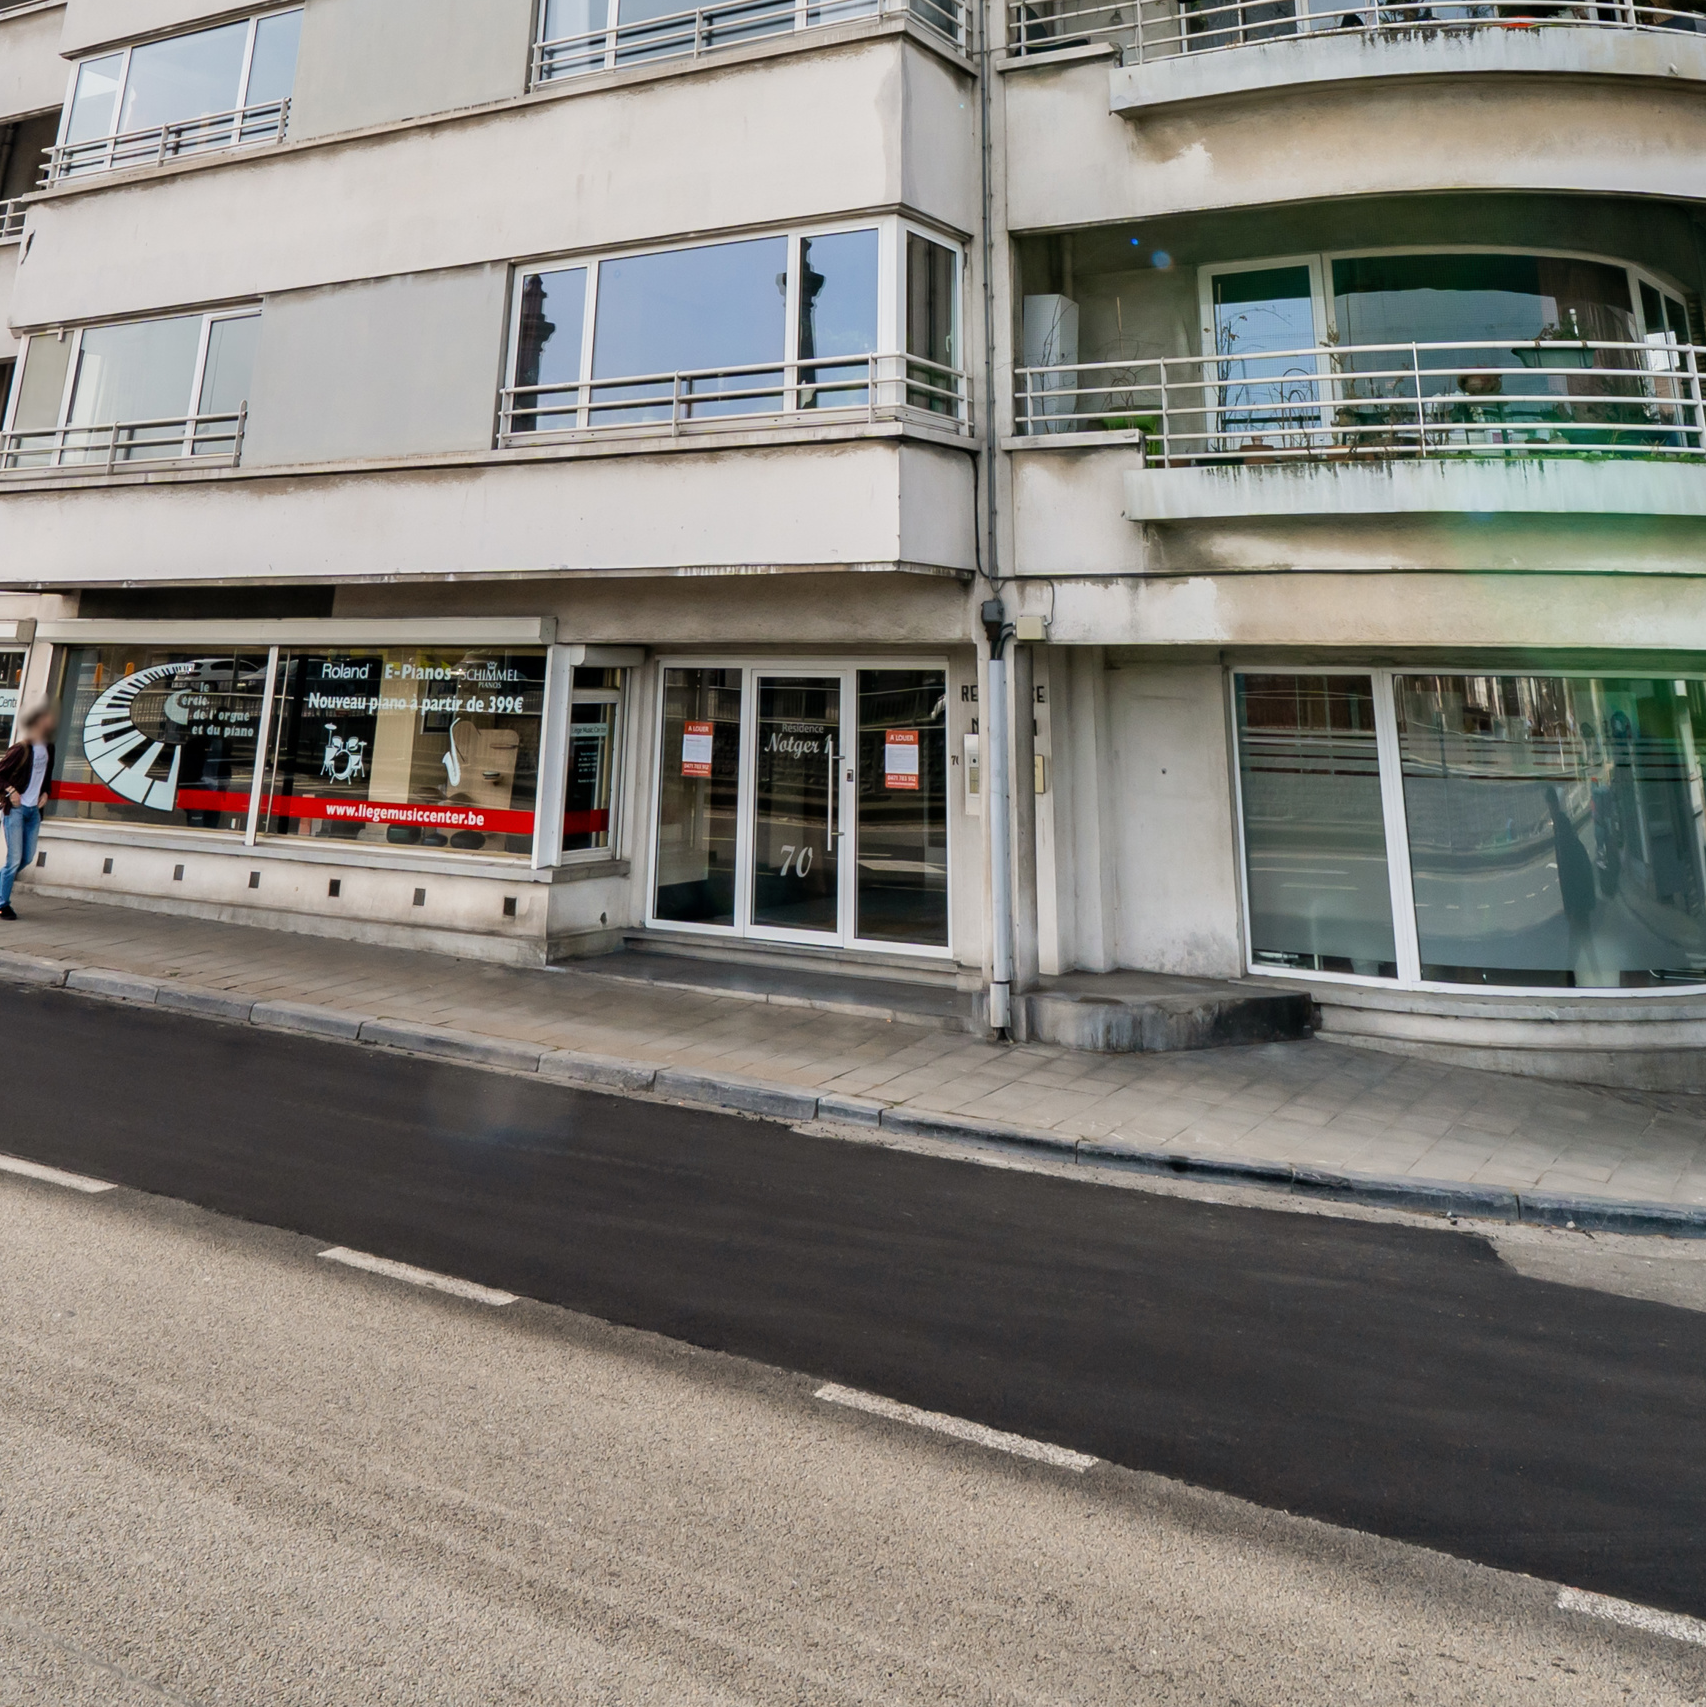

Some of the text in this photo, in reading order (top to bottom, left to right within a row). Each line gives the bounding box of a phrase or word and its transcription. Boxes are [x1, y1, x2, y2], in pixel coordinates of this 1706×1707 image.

[322, 663, 370, 679] Roland
[385, 664, 452, 681] E-Pianos
[461, 668, 519, 682] SCHIMMEL
[200, 682, 210, 692] le
[478, 681, 502, 689] PIANOS
[308, 692, 524, 715] Nouveau piano à partir de 399€
[193, 709, 206, 720] de
[191, 725, 254, 737] et du piano
[782, 723, 824, 734] Résidence
[764, 732, 820, 760] Notger
[326, 804, 485, 826] www.liegemusiccenter.be
[780, 844, 814, 878] 70
